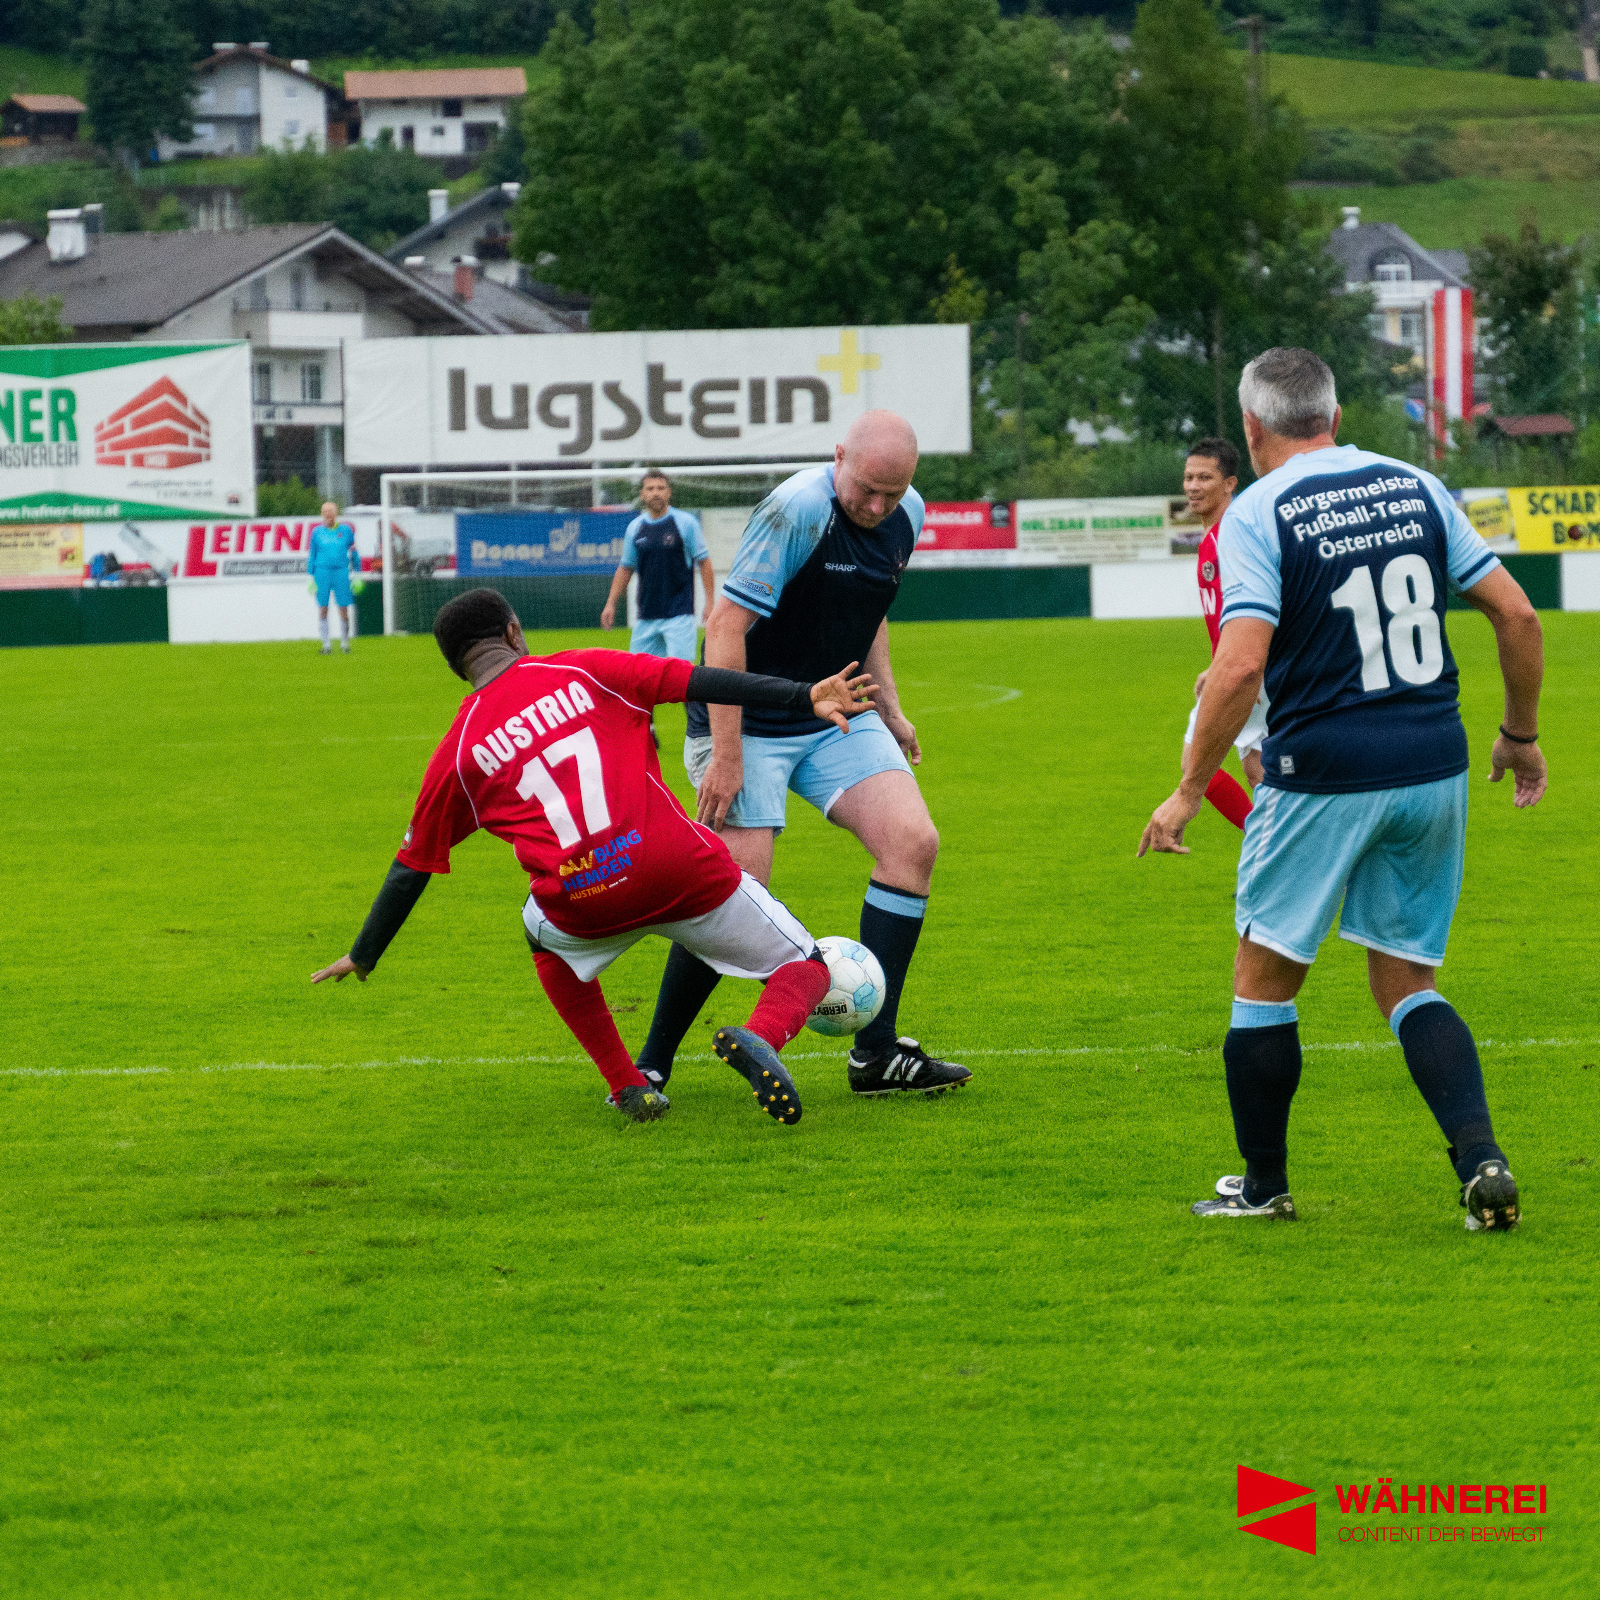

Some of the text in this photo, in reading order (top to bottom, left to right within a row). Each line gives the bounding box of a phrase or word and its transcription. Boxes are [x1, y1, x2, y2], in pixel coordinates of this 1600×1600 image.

[448, 363, 831, 456] lugstein
[1278, 475, 1420, 522] Bürgermeister
[1527, 491, 1600, 515] SCHAR
[1293, 498, 1427, 542] Fußball-Team
[1318, 519, 1424, 560] Österreich
[471, 540, 545, 561] Donau
[824, 561, 857, 573] SHARP
[1331, 553, 1444, 692] 18
[471, 680, 596, 777] AUSTRIA
[515, 726, 612, 850] 17
[594, 829, 642, 863] BURG
[563, 853, 632, 892] HEMDEN
[569, 883, 608, 900] AUSTRIA
